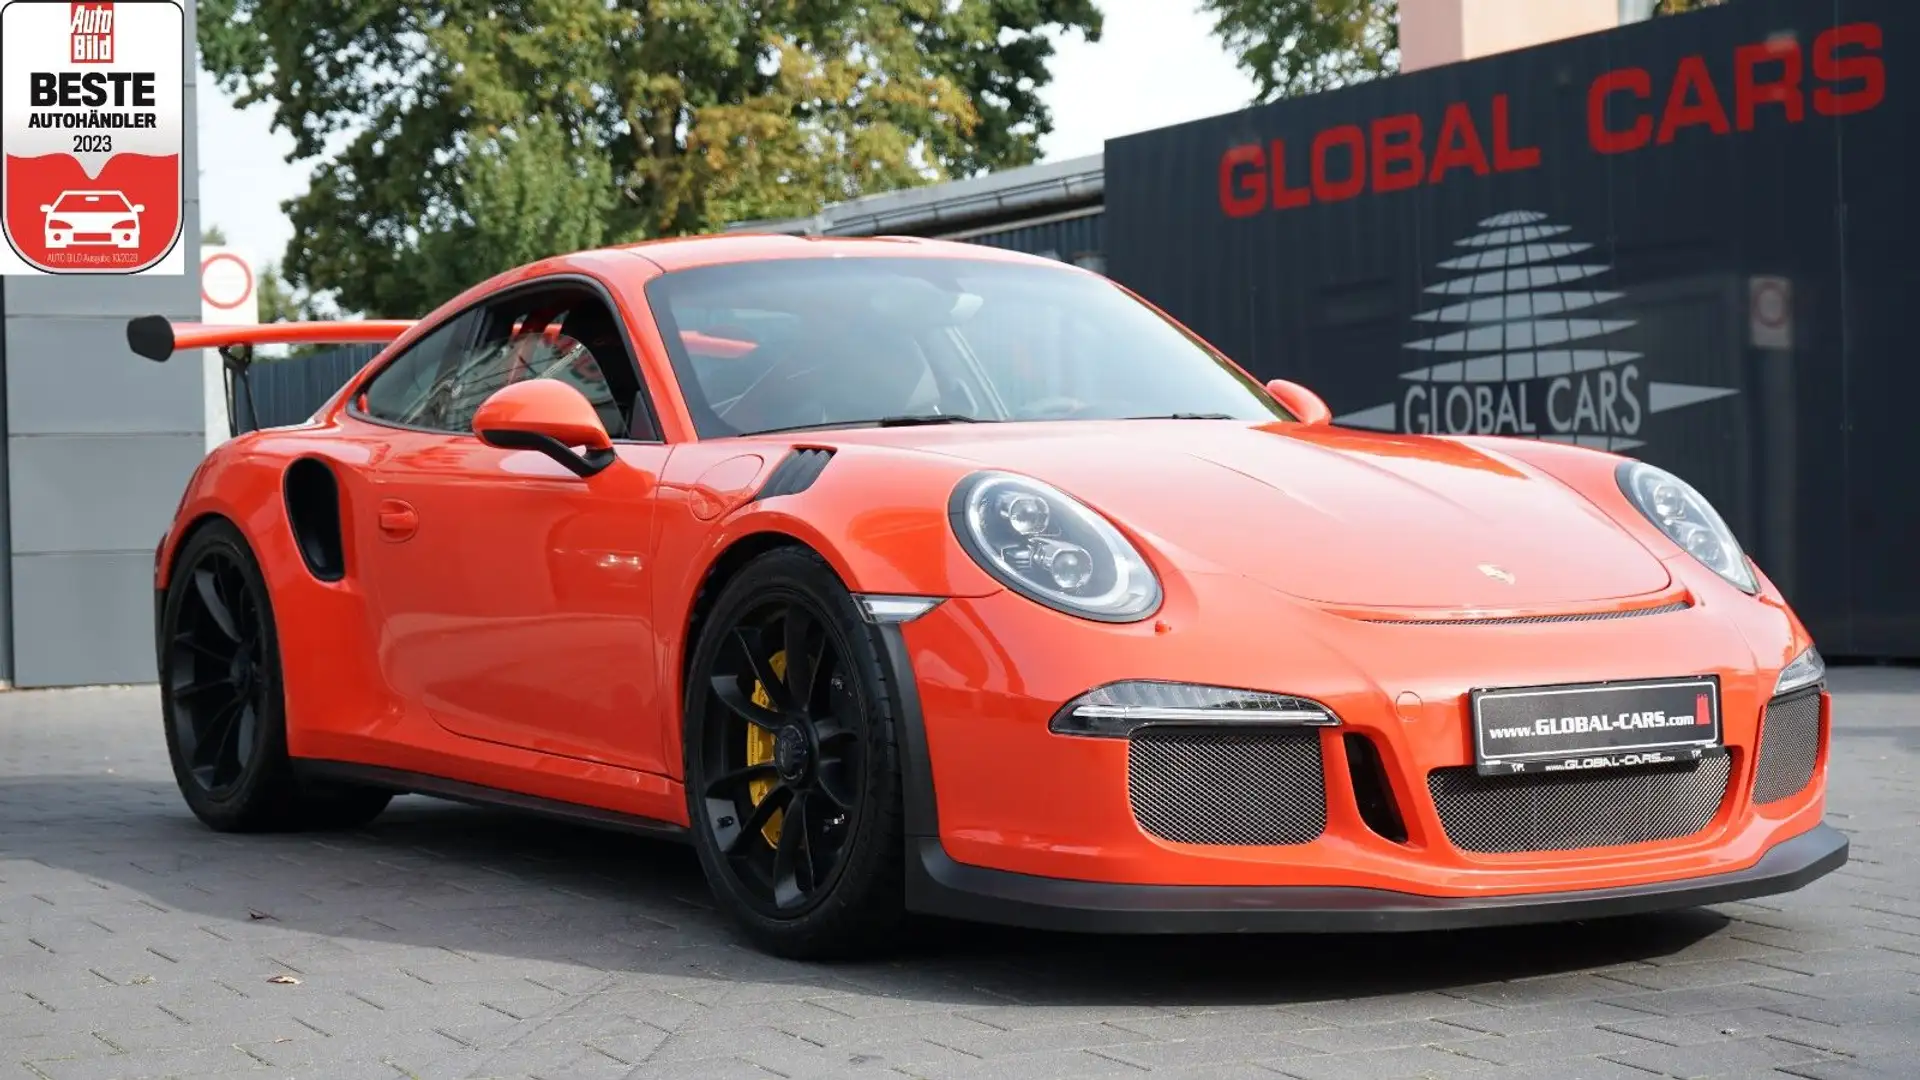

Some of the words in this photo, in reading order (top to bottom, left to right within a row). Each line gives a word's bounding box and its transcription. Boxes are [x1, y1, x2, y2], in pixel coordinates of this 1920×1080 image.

[1219, 94, 1541, 218] GLOBAL
[1587, 22, 1886, 154] CARS
[1403, 383, 1537, 435] GLOBAL
[1546, 364, 1642, 435] CARS
[1489, 710, 1695, 740] www.GLOBAL-CARS.com
